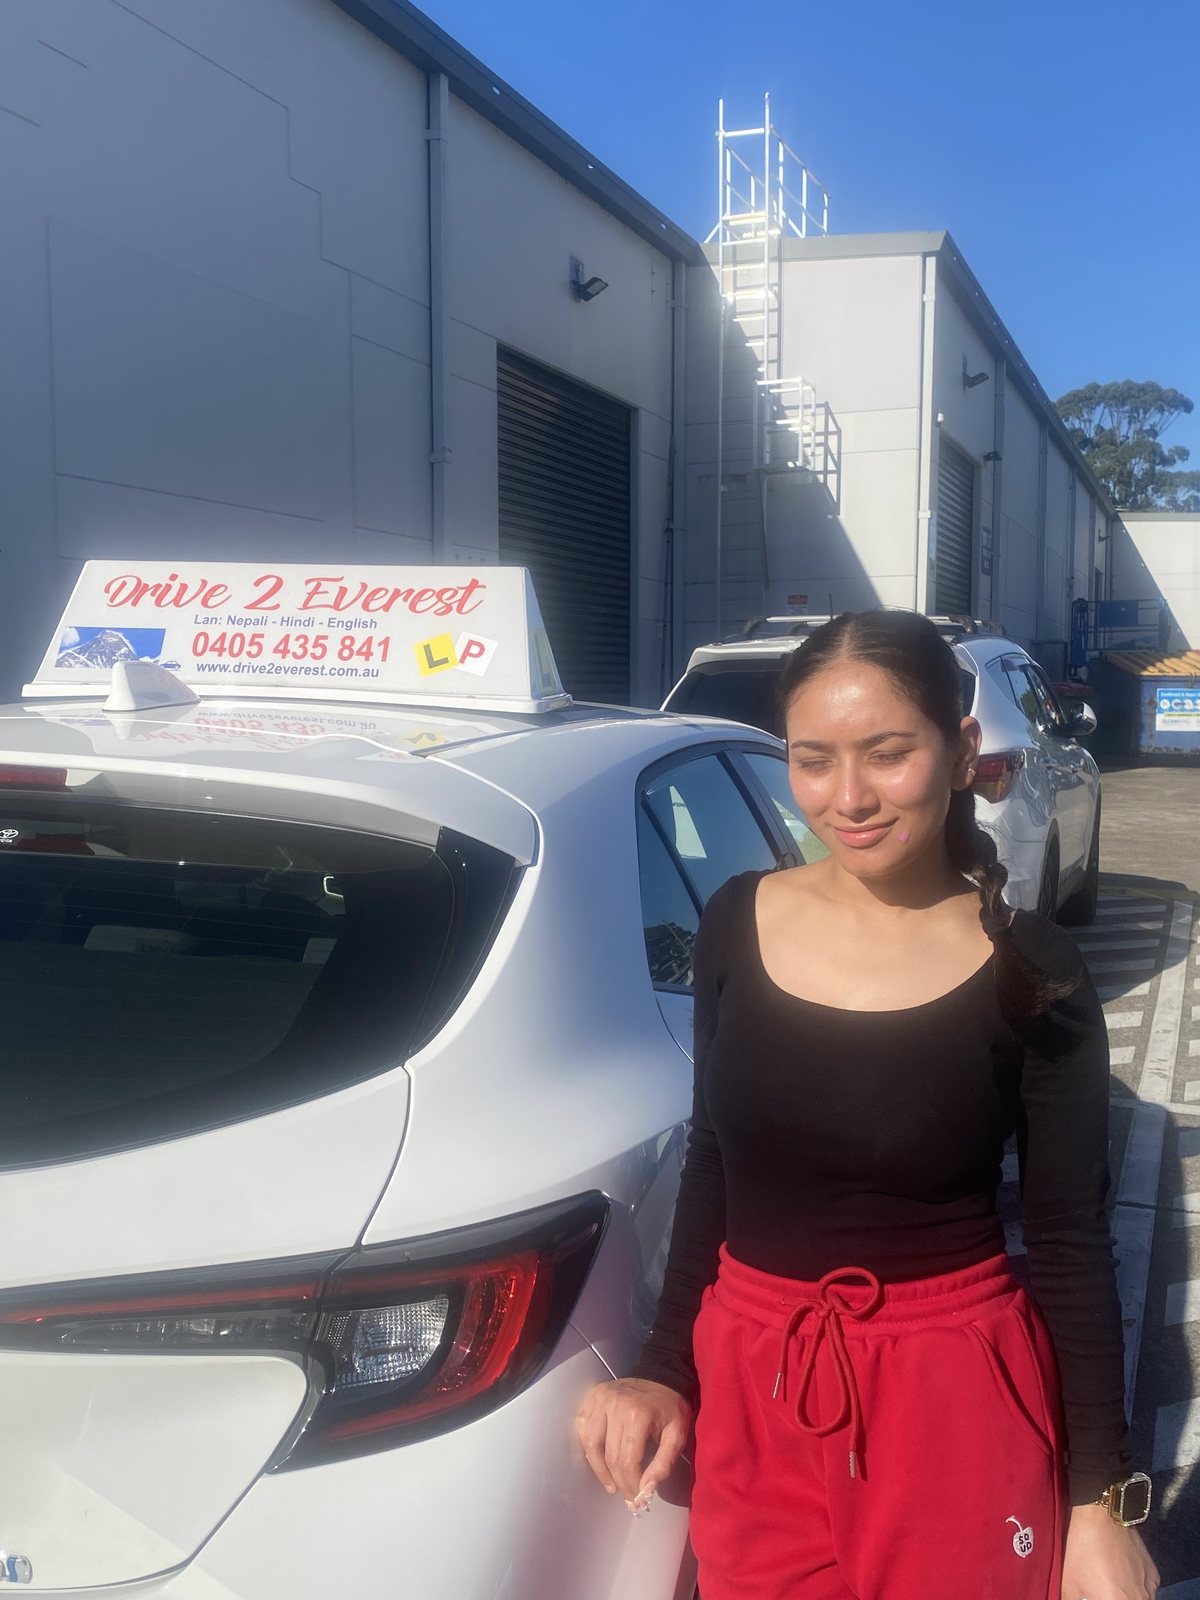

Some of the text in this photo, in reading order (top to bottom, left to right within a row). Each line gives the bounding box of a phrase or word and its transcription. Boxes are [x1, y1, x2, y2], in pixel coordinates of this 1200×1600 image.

[103, 573, 487, 616] Drive 2 Everest
[194, 614, 222, 625] Lan:
[226, 615, 268, 628] Nepali
[280, 616, 315, 627] Hindi
[327, 617, 378, 631] English
[192, 631, 390, 662] 0405 435 841
[423, 644, 449, 669] L
[459, 639, 485, 664] P
[196, 661, 379, 678] www.drive2everest.com.au
